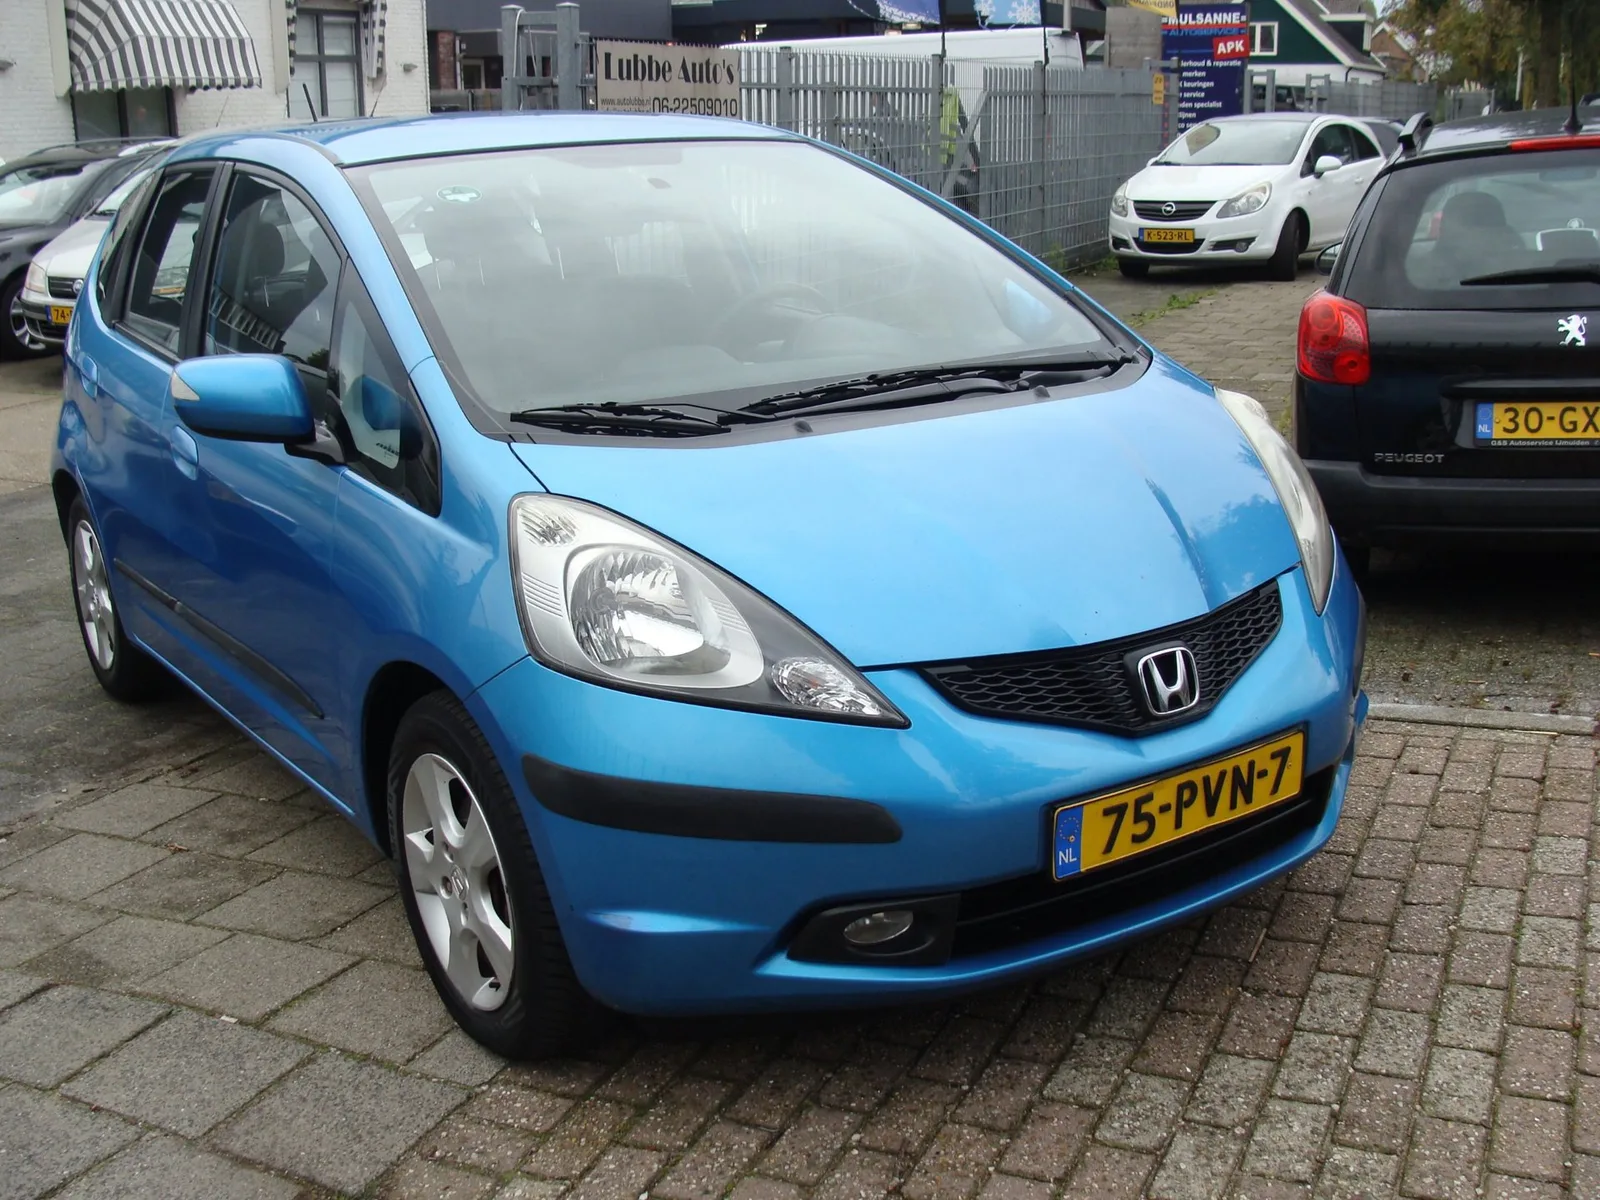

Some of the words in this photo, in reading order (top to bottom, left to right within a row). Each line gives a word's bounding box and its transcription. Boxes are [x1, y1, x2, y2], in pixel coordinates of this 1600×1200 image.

[1168, 13, 1240, 25] MULSANNE
[1217, 40, 1244, 54] APK
[604, 52, 672, 82] Lubbe
[678, 55, 734, 85] Auto's
[1213, 60, 1241, 68] reparatie
[1184, 81, 1214, 89] keuringen
[653, 97, 737, 117] 06-22509010
[1194, 101, 1222, 109] specialist
[1147, 231, 1190, 241] K-523-RL
[1502, 406, 1600, 434] 30-GX
[1478, 424, 1491, 433] NL
[1374, 453, 1445, 463] PEUGEOT
[1102, 746, 1291, 855] 75-PVN-7
[1058, 847, 1078, 866] NL
